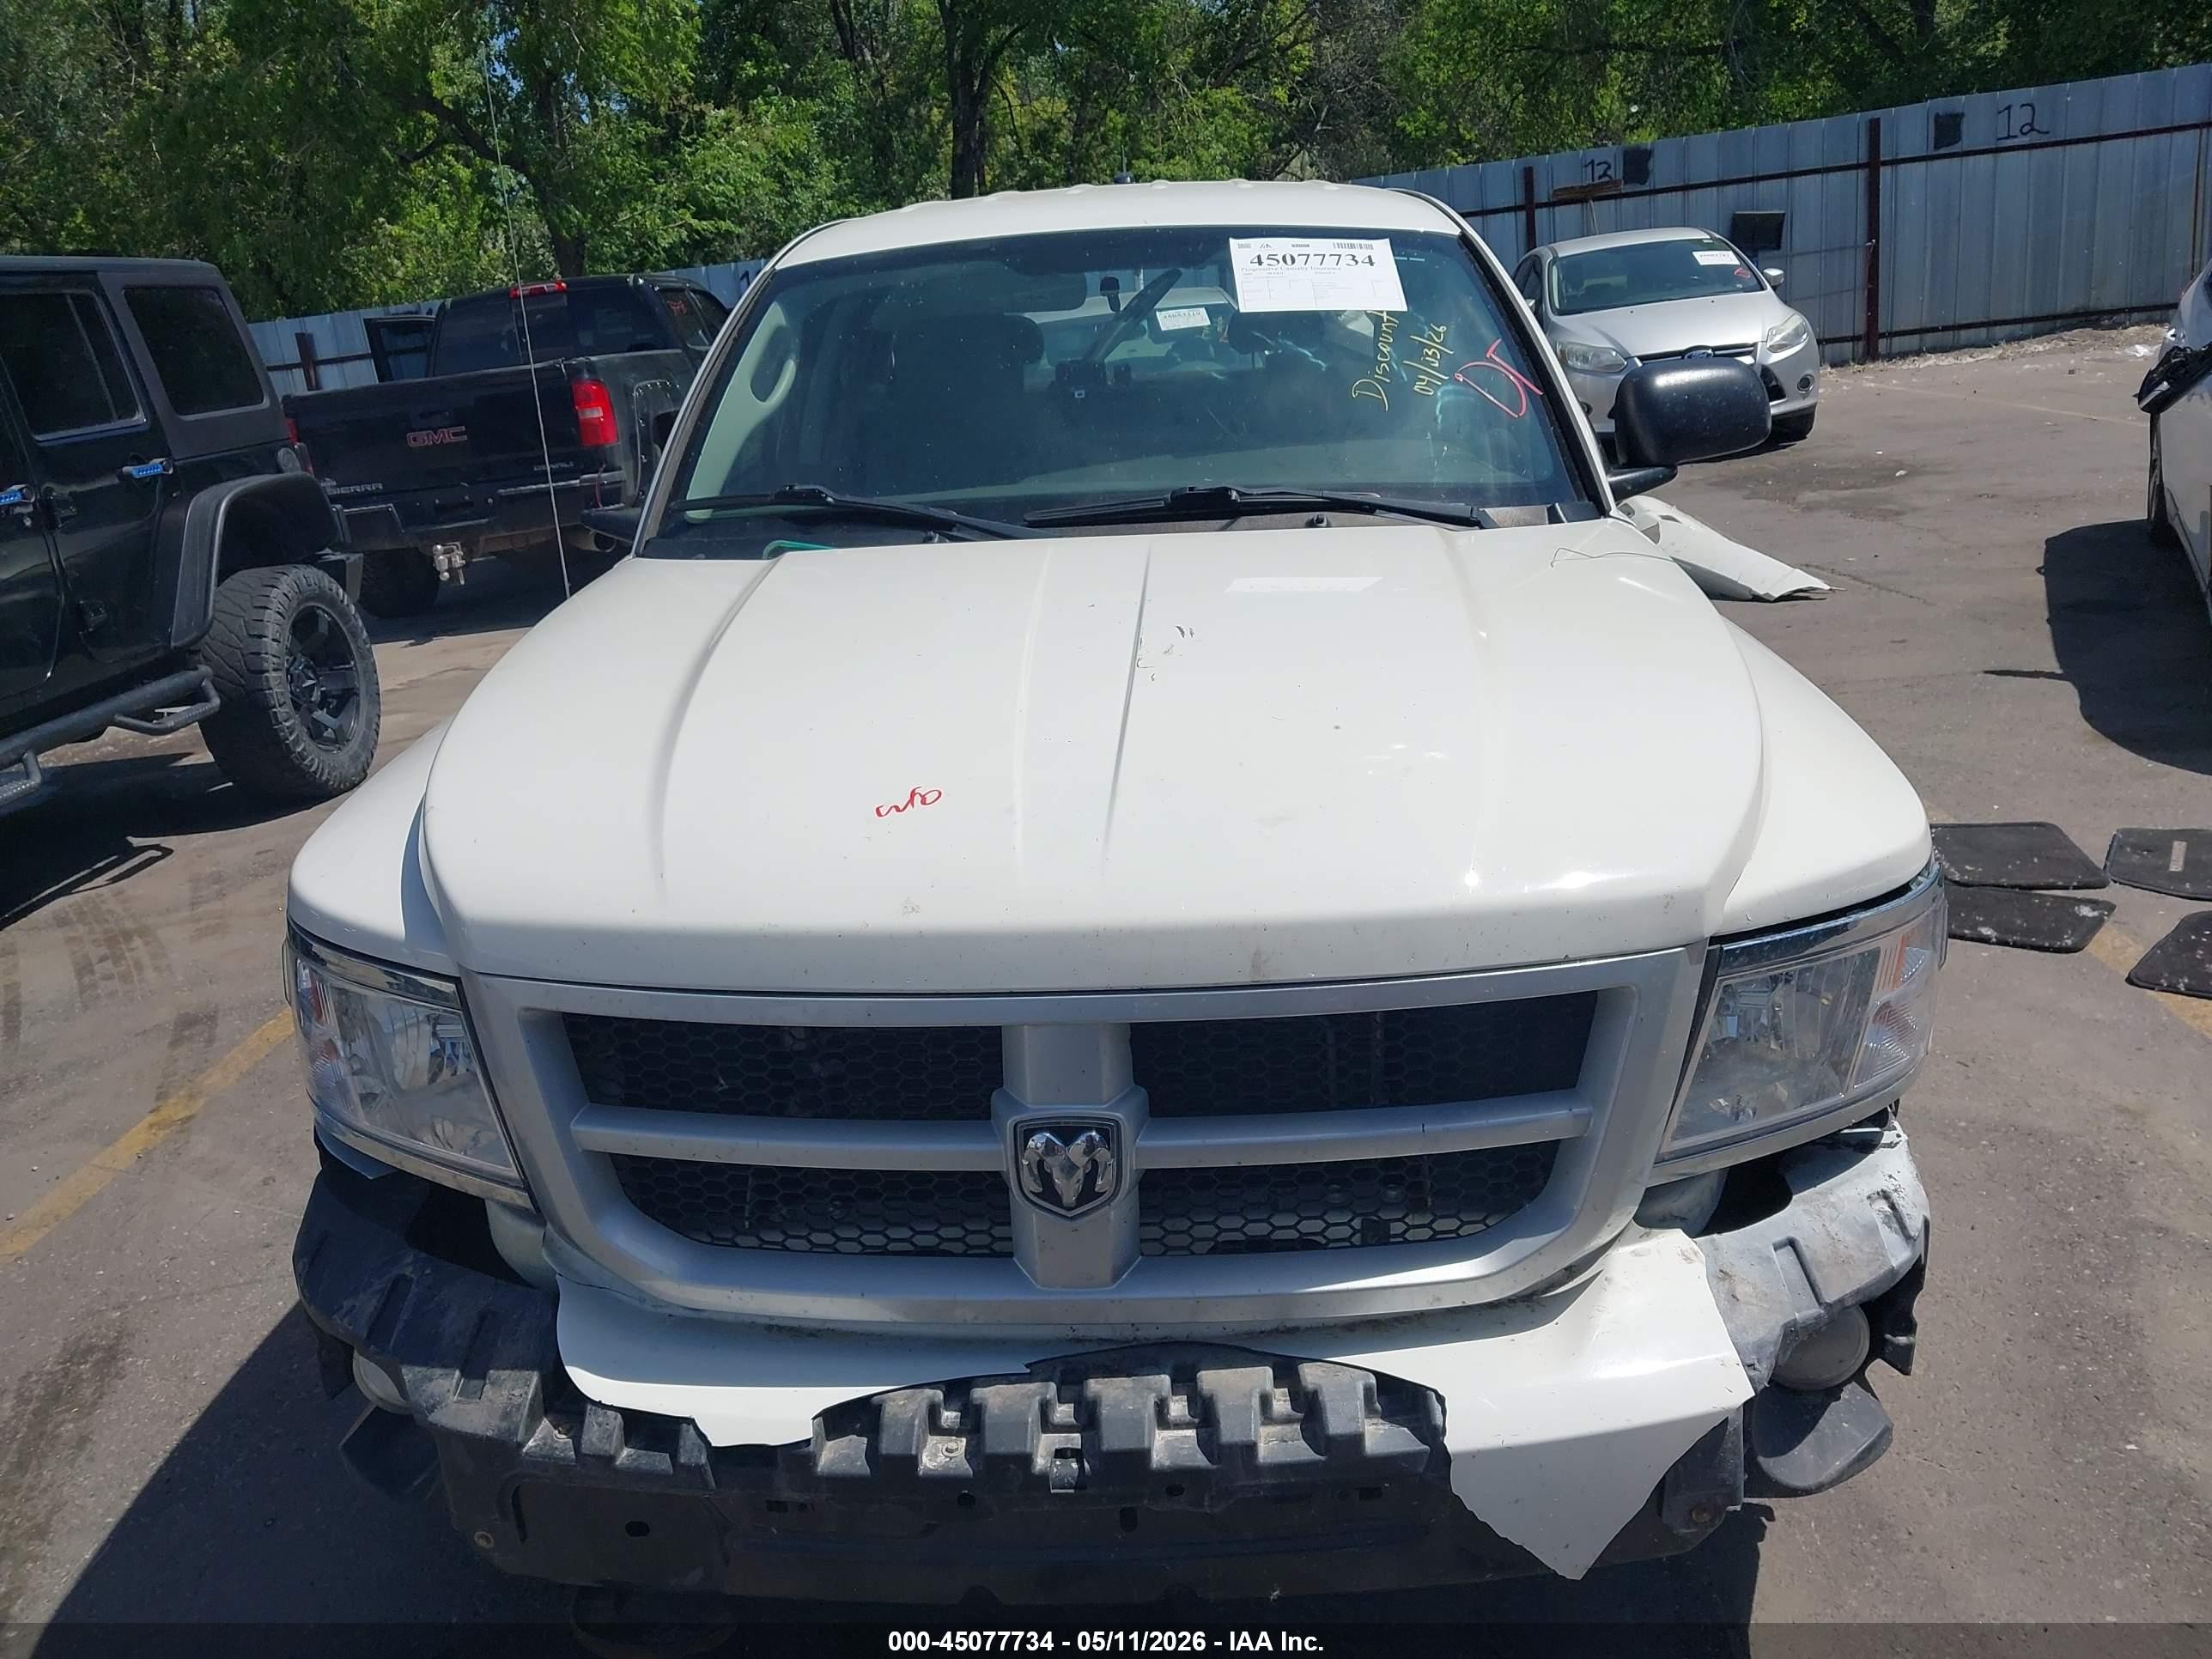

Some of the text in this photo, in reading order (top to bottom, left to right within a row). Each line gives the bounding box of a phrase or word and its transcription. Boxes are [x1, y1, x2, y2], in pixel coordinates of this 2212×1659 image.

[1996, 102, 2051, 142] 12
[1249, 252, 1376, 267] 45077734
[1352, 310, 1401, 412] Discount
[406, 425, 469, 447] GMC
